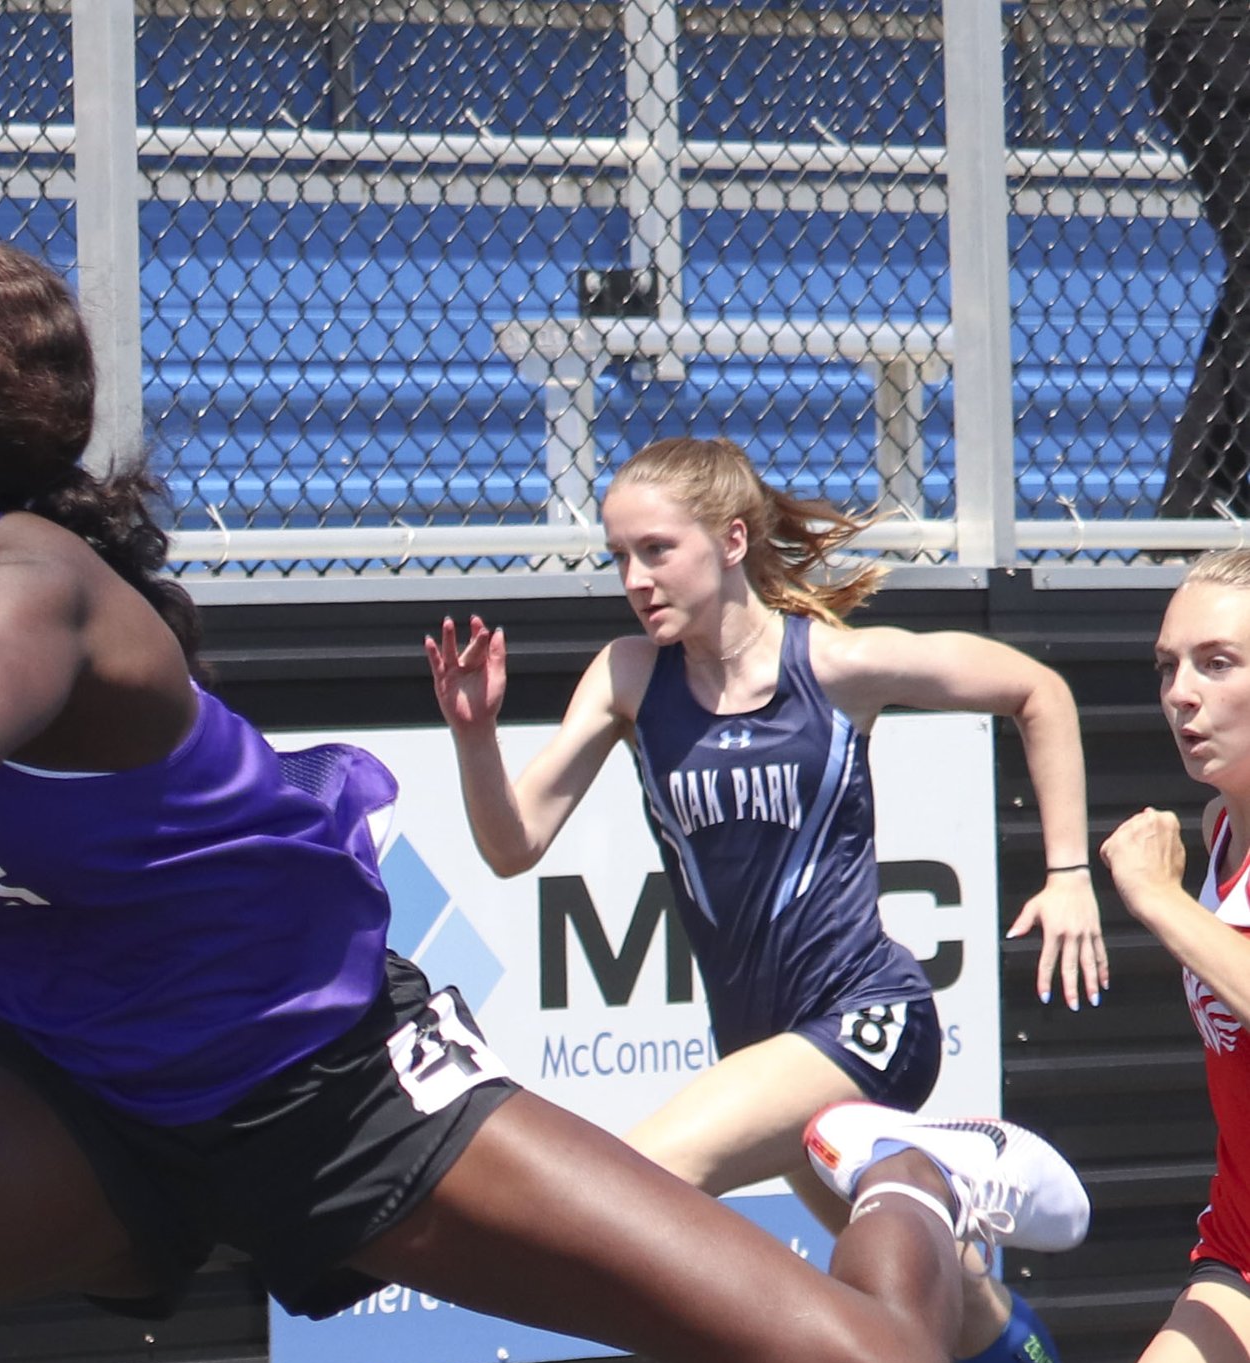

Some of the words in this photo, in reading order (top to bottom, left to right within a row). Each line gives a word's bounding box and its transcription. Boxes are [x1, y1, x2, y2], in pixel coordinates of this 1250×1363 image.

[669, 769, 725, 836] OAK
[731, 763, 803, 831] PARK
[541, 1027, 716, 1079] McConnel
[852, 1004, 895, 1053] 8
